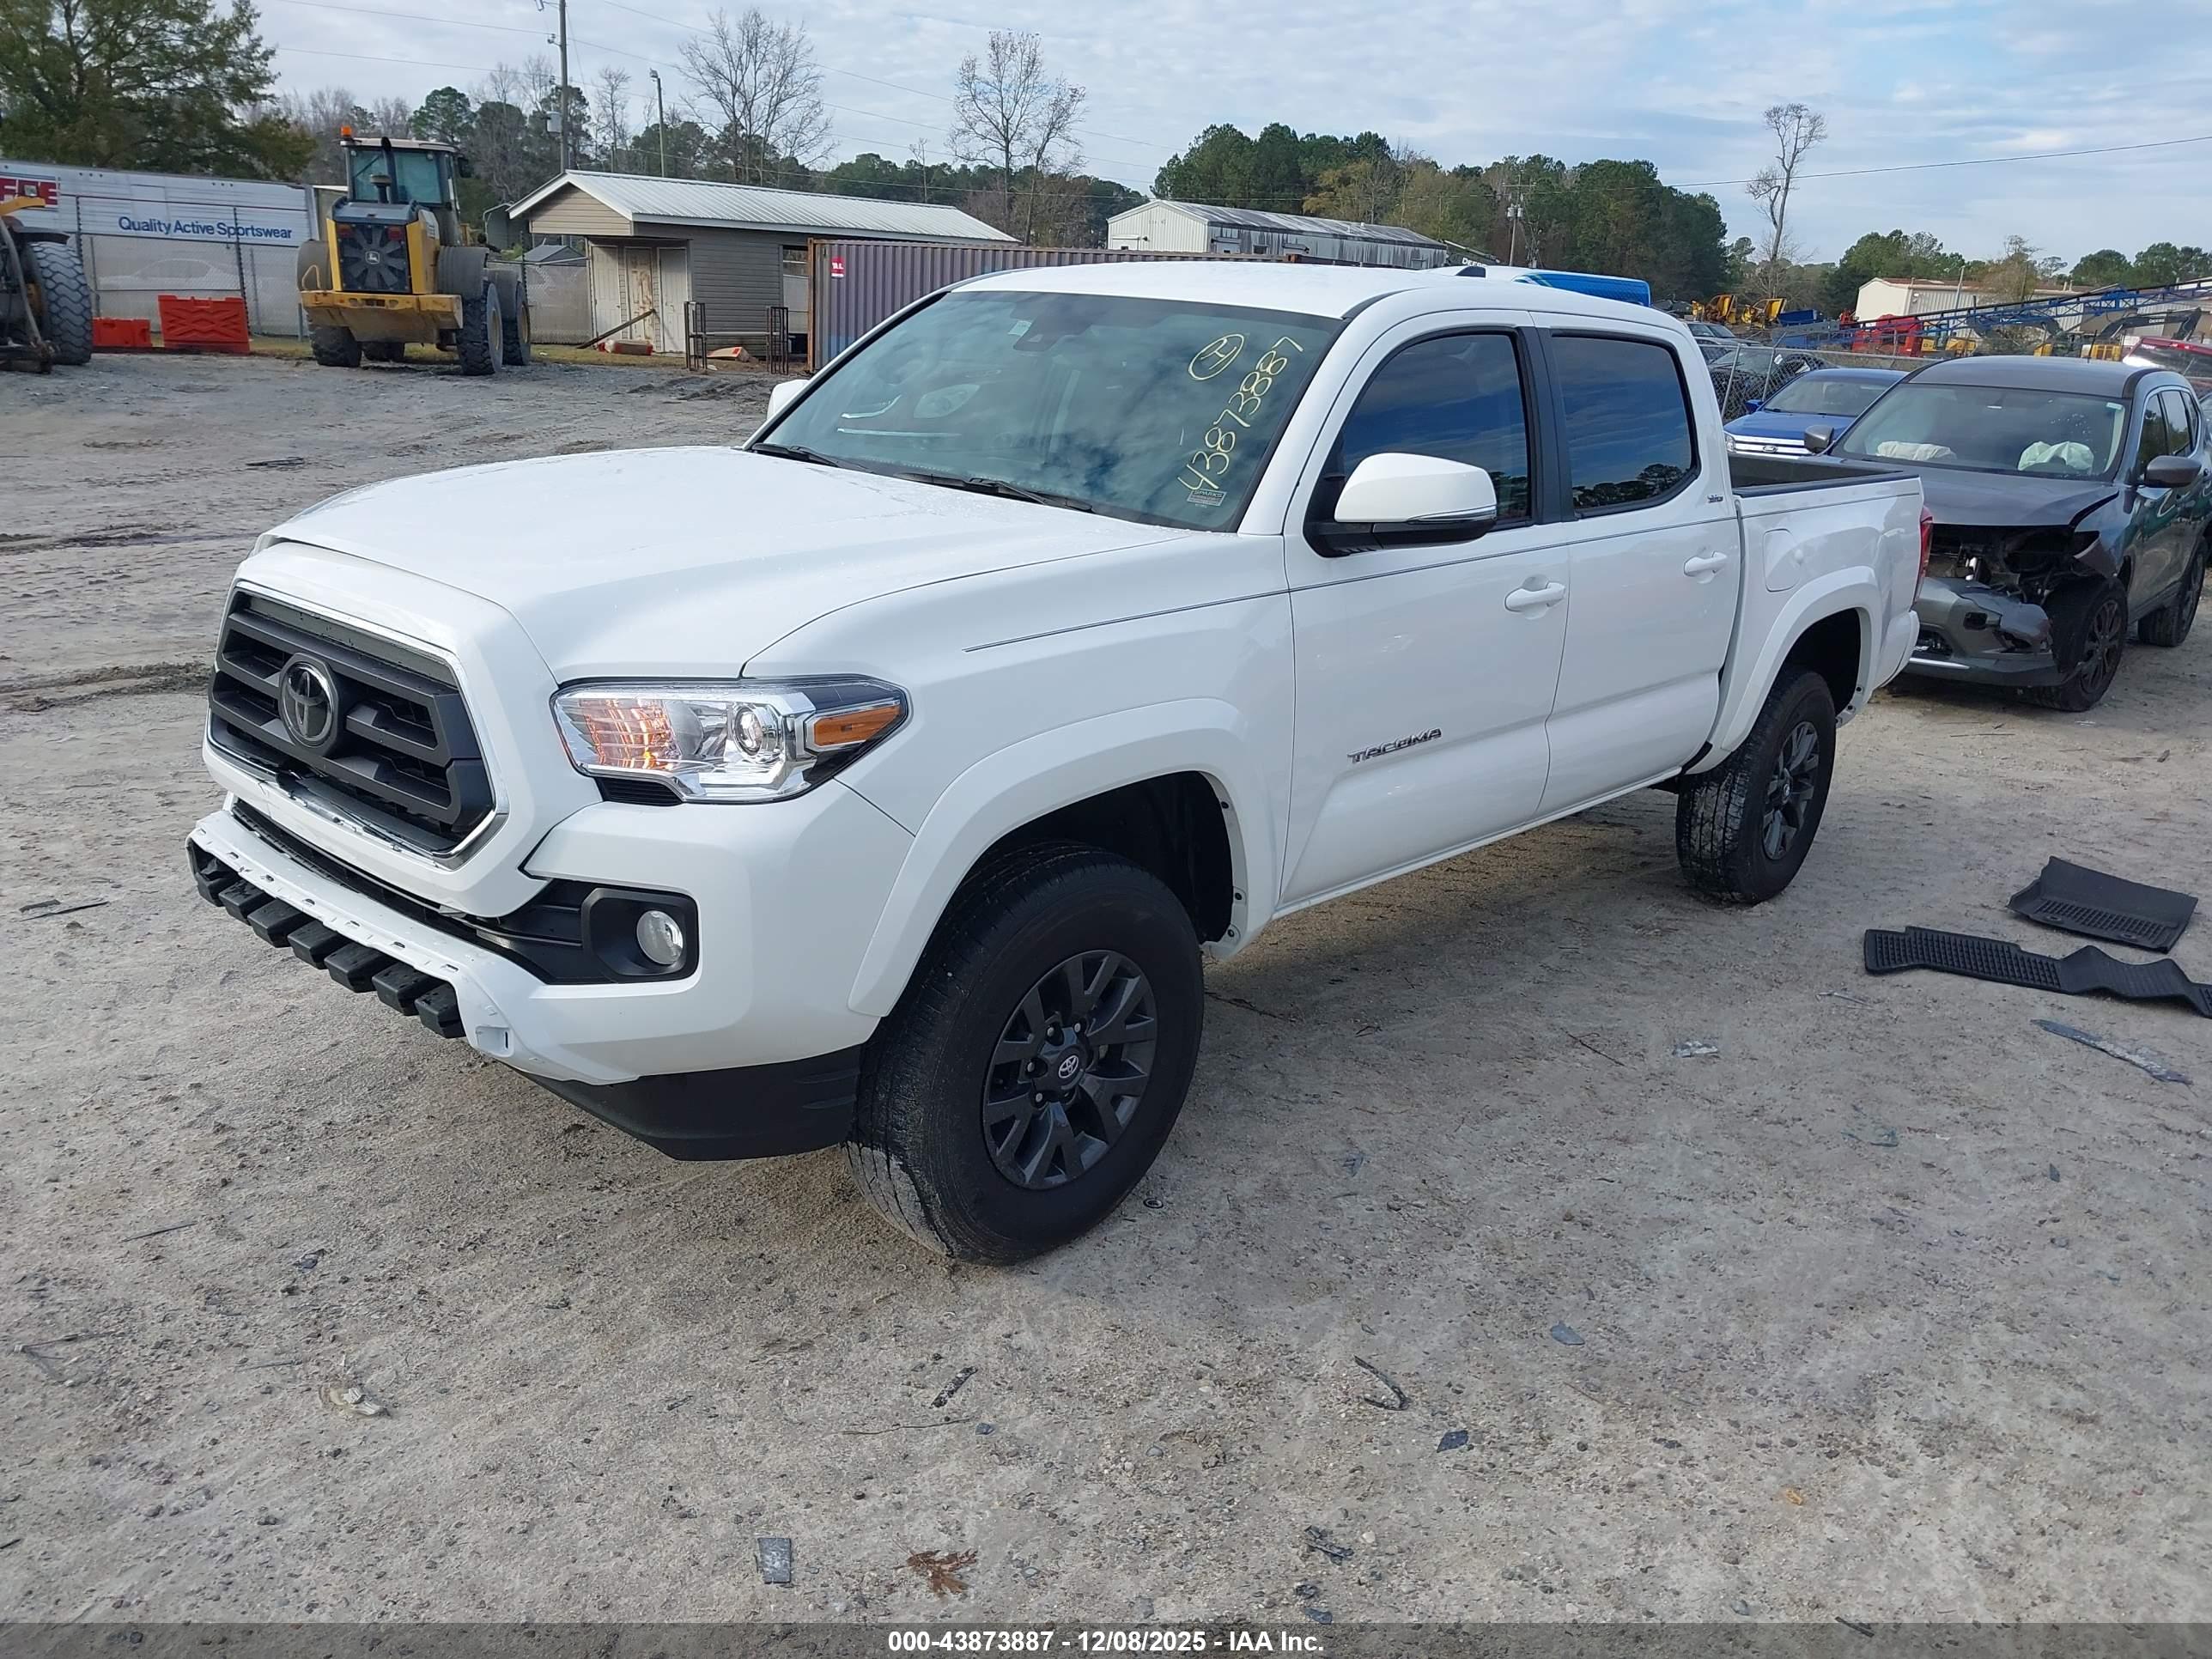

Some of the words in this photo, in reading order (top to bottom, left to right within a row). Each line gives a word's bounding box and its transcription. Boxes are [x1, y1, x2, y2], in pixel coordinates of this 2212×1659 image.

[118, 216, 171, 234] Quality
[173, 220, 214, 234] Active
[216, 222, 292, 239] Sportswear
[1177, 337, 1304, 489] 43873887
[1346, 728, 1443, 763] TACOMA
